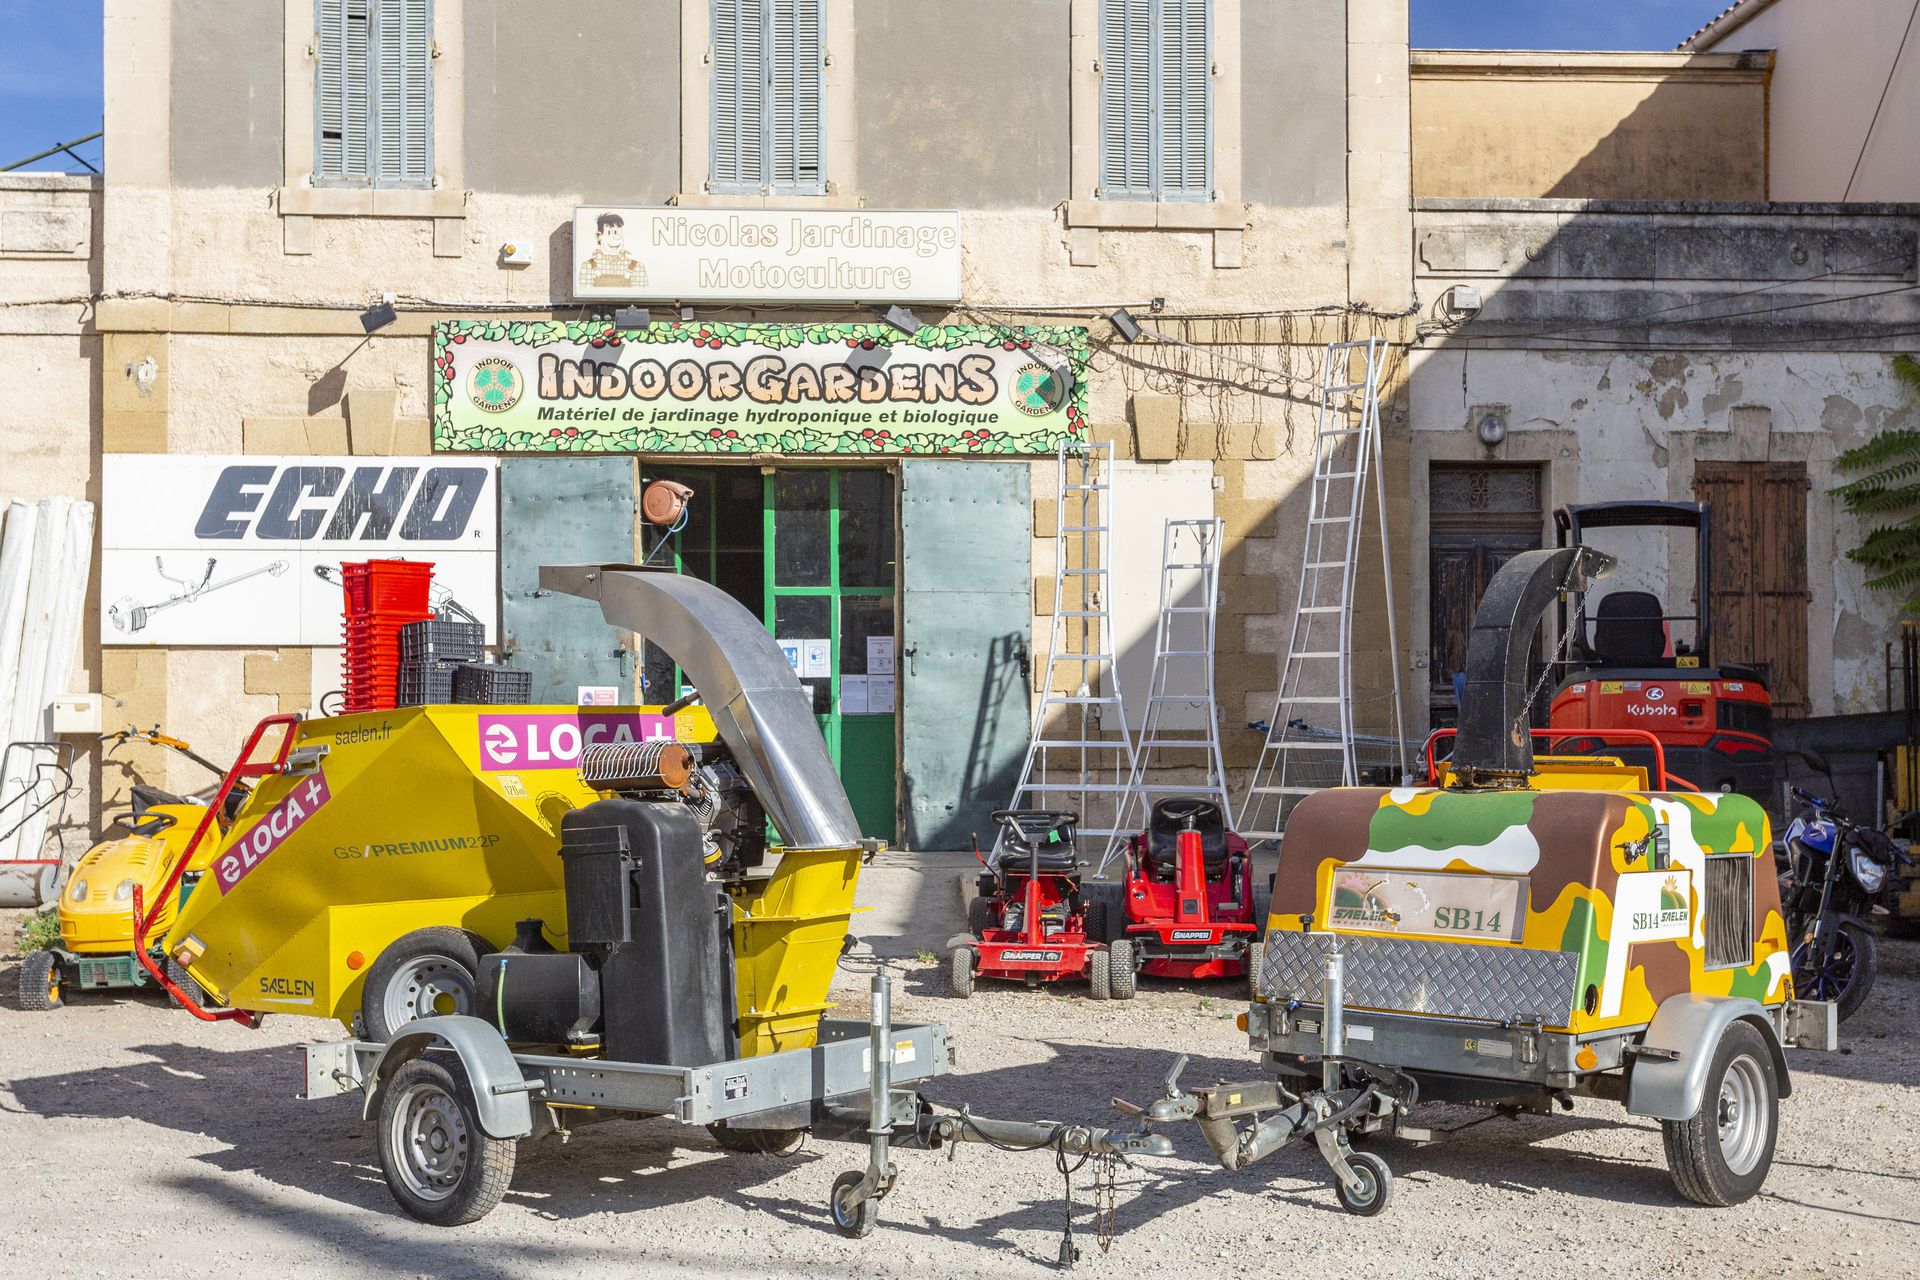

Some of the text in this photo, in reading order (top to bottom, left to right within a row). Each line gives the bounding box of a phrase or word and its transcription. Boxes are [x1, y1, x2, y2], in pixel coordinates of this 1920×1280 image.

[652, 215, 957, 257] Nicolas Jardinage
[699, 257, 911, 290] Motoculture
[475, 358, 513, 370] INDOOR
[1017, 362, 1054, 375] INDOOR
[473, 396, 516, 411] GARDENS
[1015, 400, 1057, 414] GARDENS
[537, 407, 999, 426] Matériel de jardinage hydroponique et biologique
[194, 465, 488, 540] ECHO
[1627, 704, 1677, 716] Kubota
[335, 721, 392, 745] saelen.fr
[1433, 906, 1501, 933] SB14
[1632, 911, 1688, 930] SB14 SAELEN
[1173, 931, 1209, 940] SNAPPER
[1002, 951, 1042, 960] SNAPPER
[260, 977, 314, 996] SAELEN
